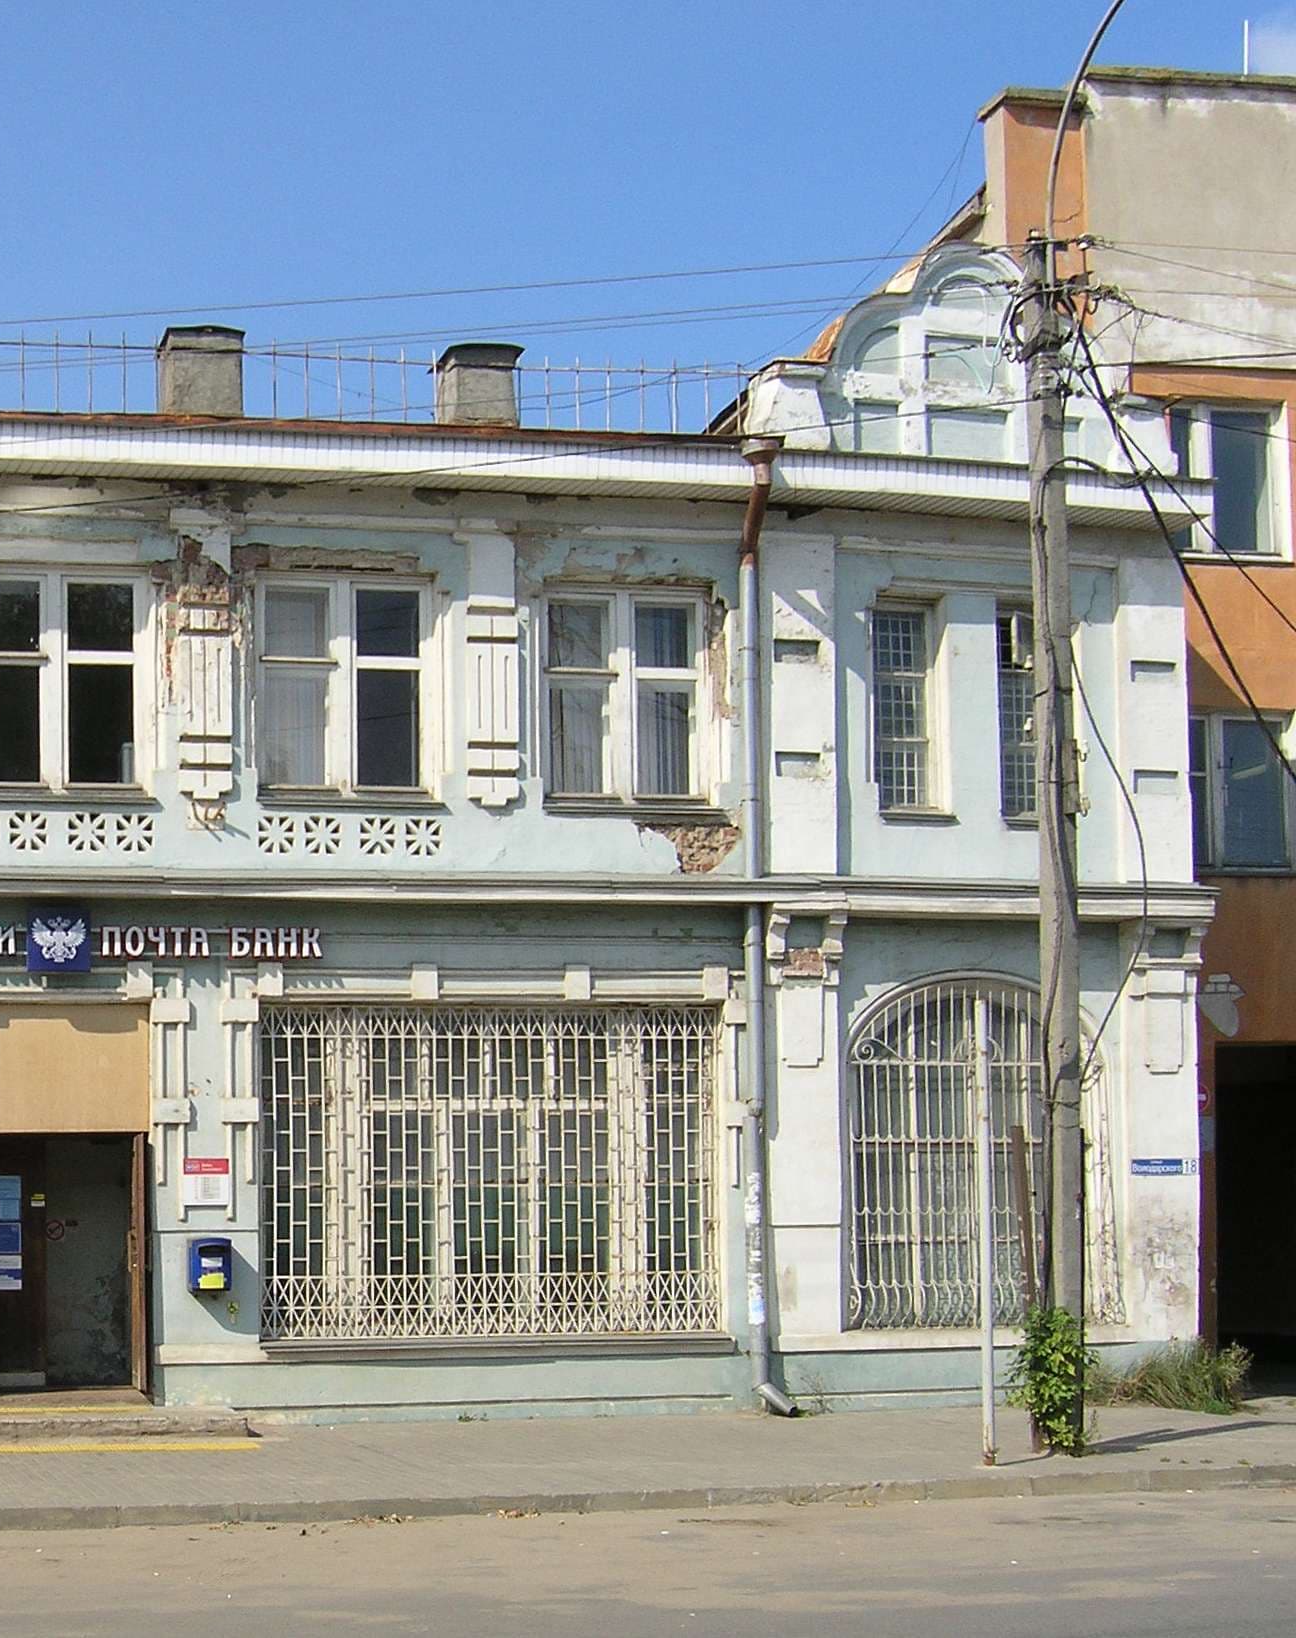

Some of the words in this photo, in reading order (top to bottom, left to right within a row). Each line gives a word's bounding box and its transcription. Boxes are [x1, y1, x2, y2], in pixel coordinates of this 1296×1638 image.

[102, 926, 209, 957] ПОЧТА
[231, 928, 322, 957] БАНК
[1185, 1160, 1197, 1173] 18
